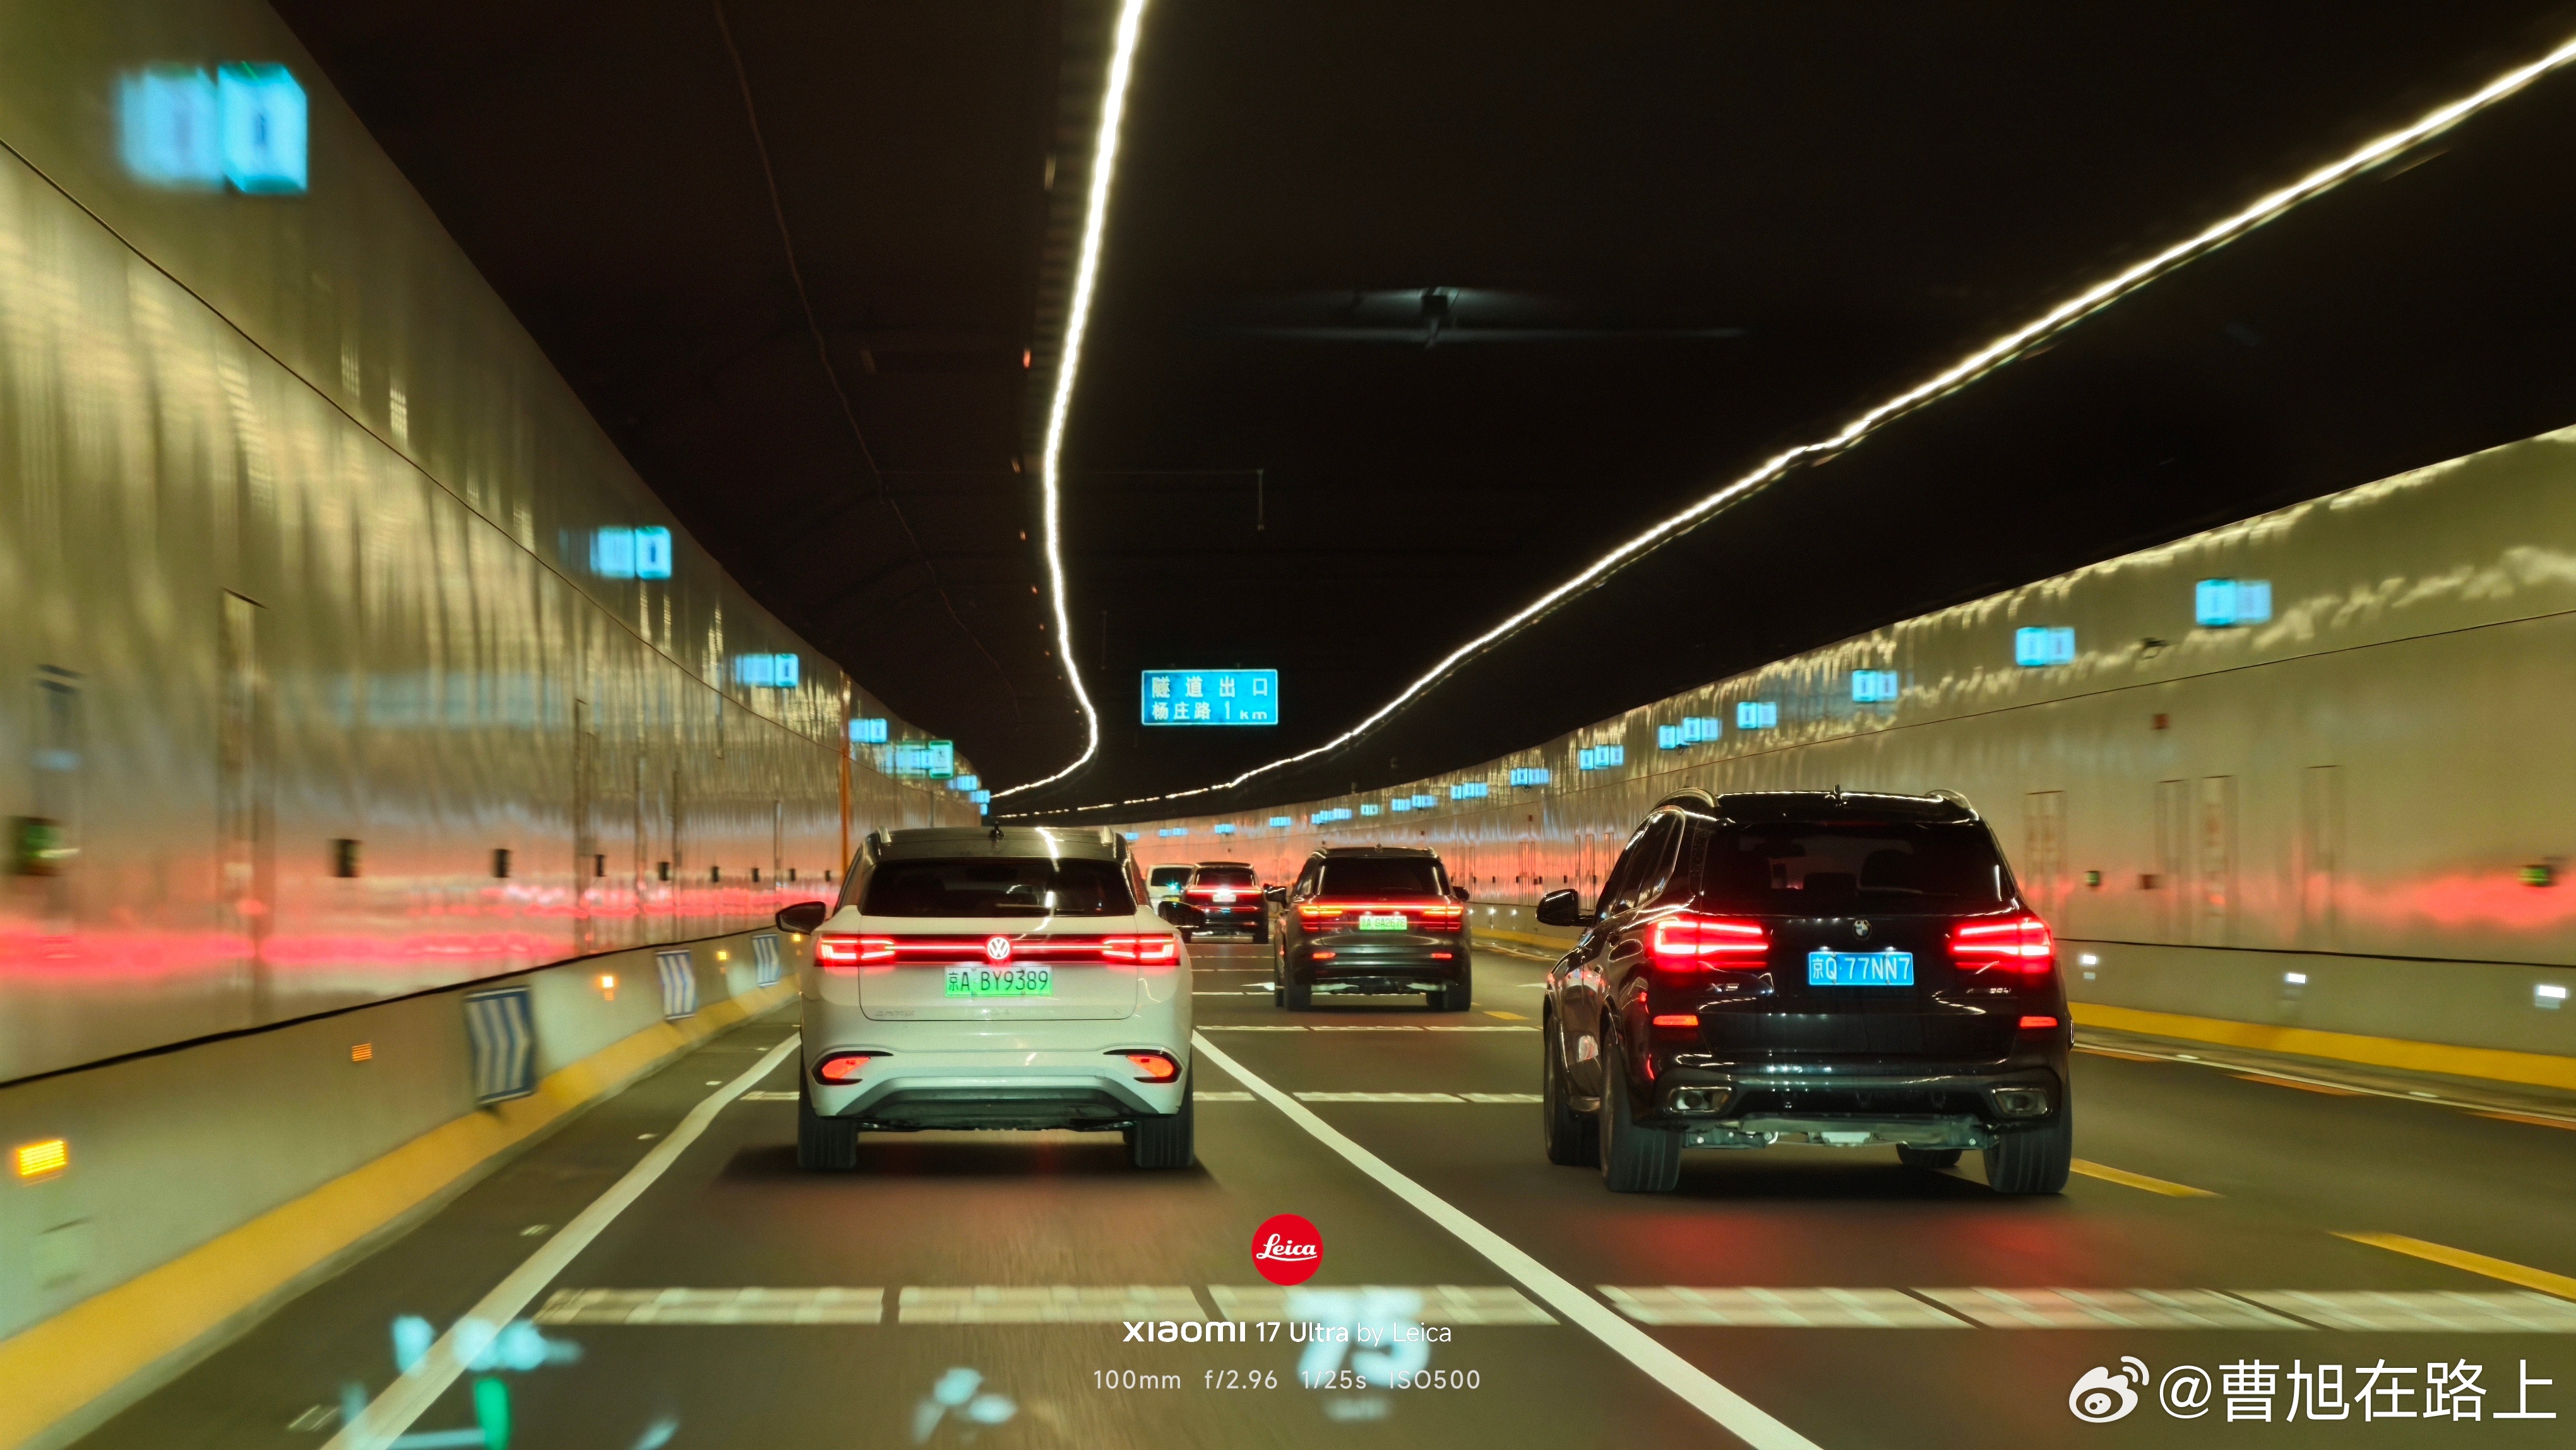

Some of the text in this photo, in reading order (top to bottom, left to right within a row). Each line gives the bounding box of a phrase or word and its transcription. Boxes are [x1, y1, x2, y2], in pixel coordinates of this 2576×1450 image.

[1152, 676, 1268, 698] 隧道出口
[1152, 701, 1211, 720] 杨庄路
[1224, 700, 1231, 720] 1
